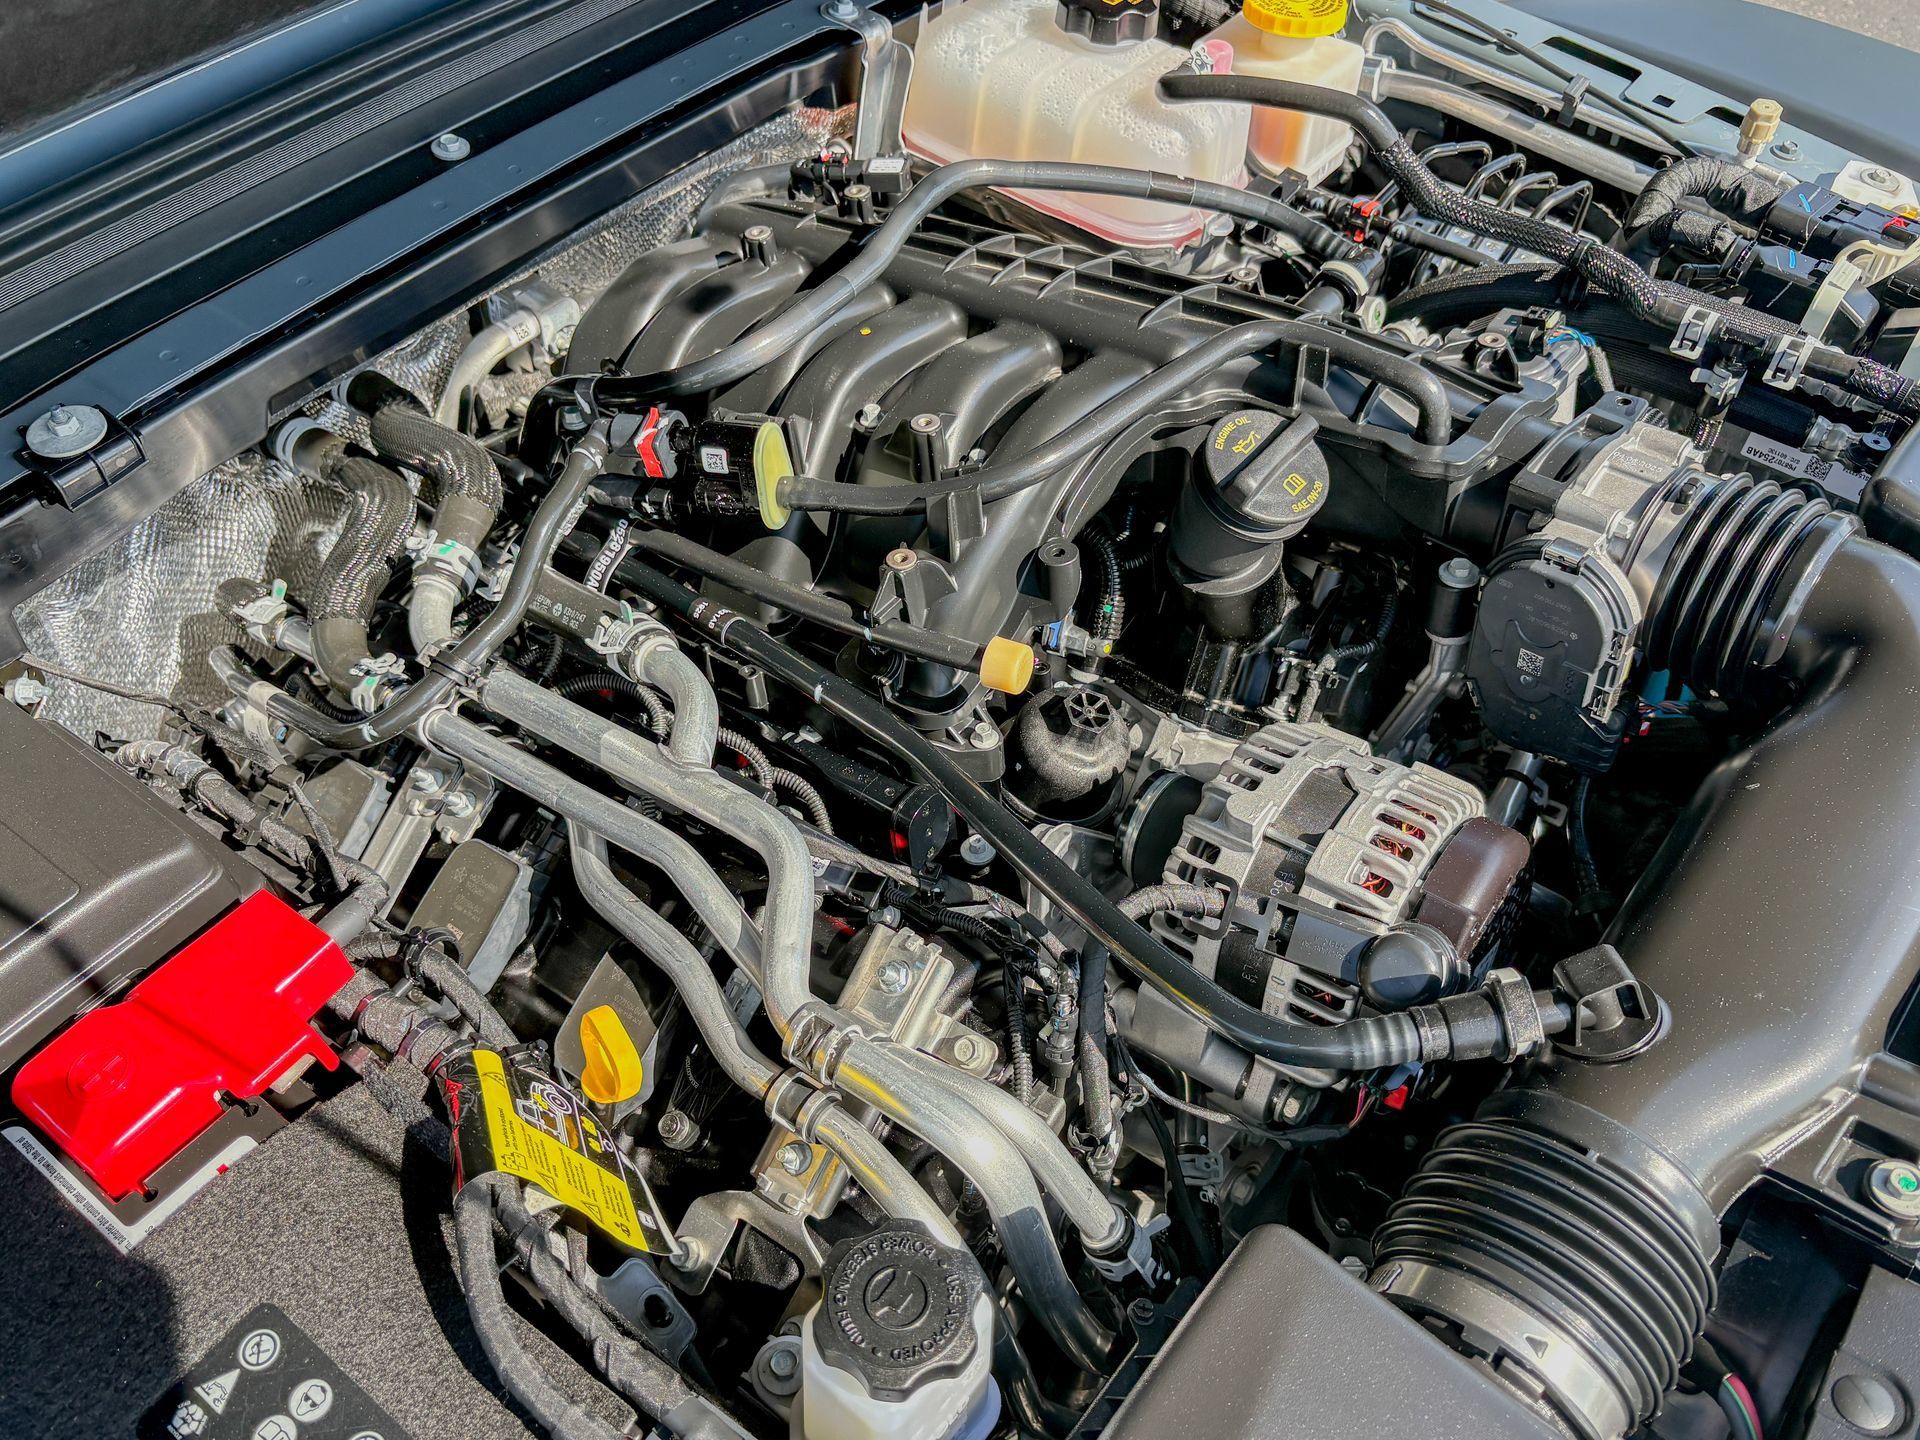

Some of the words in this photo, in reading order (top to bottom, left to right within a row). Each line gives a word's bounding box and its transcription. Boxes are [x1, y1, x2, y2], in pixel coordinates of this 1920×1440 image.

[1215, 421, 1237, 450] ENGINE
[1235, 416, 1251, 426] OIL
[1291, 500, 1309, 514] SAE
[1308, 481, 1324, 507] 0W-20
[16, 1136, 25, 1144] of
[21, 1141, 36, 1154] State
[32, 1150, 42, 1160] the
[38, 1156, 46, 1164] to
[42, 1160, 58, 1176] known
[54, 1173, 77, 1196] chemicals
[75, 1192, 86, 1204] other
[82, 1200, 100, 1218] contain
[98, 1214, 110, 1227] also
[106, 1222, 126, 1245] Batteries
[880, 1236, 938, 1261] POWER
[833, 1242, 877, 1307] STEERING
[944, 1271, 965, 1305] USE
[836, 1309, 867, 1349] FLUID
[890, 1306, 961, 1363] APPROVED
